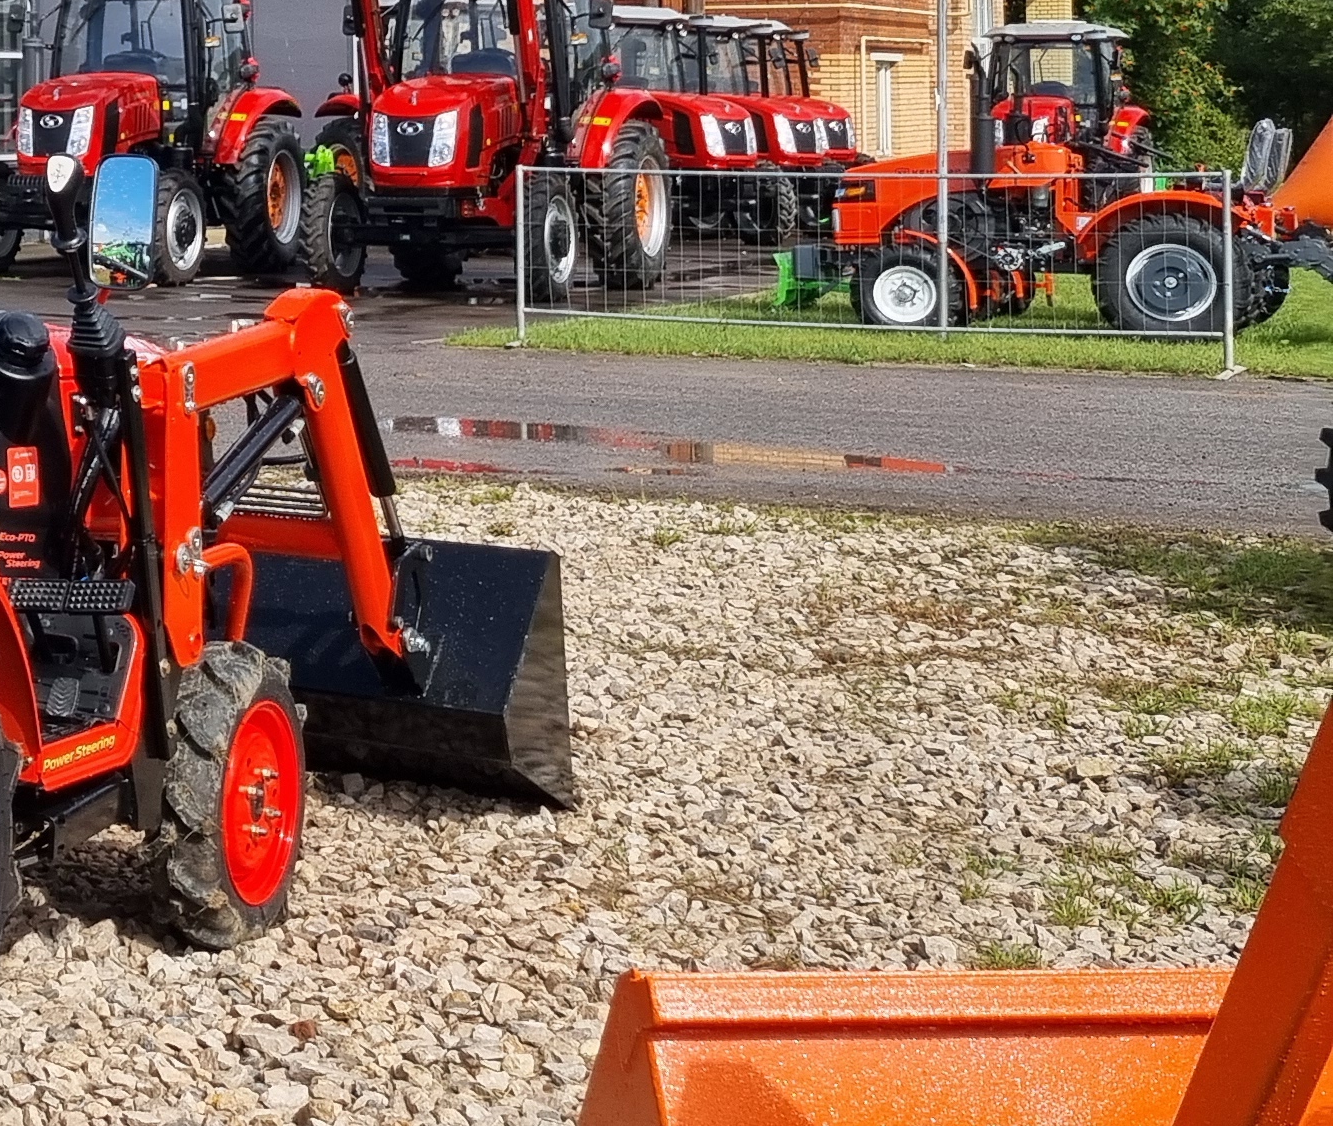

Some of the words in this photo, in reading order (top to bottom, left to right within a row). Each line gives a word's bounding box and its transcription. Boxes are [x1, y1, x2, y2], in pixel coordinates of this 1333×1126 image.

[4, 558, 41, 570] Steering
[42, 751, 75, 773] Power
[75, 735, 116, 760] Steering
